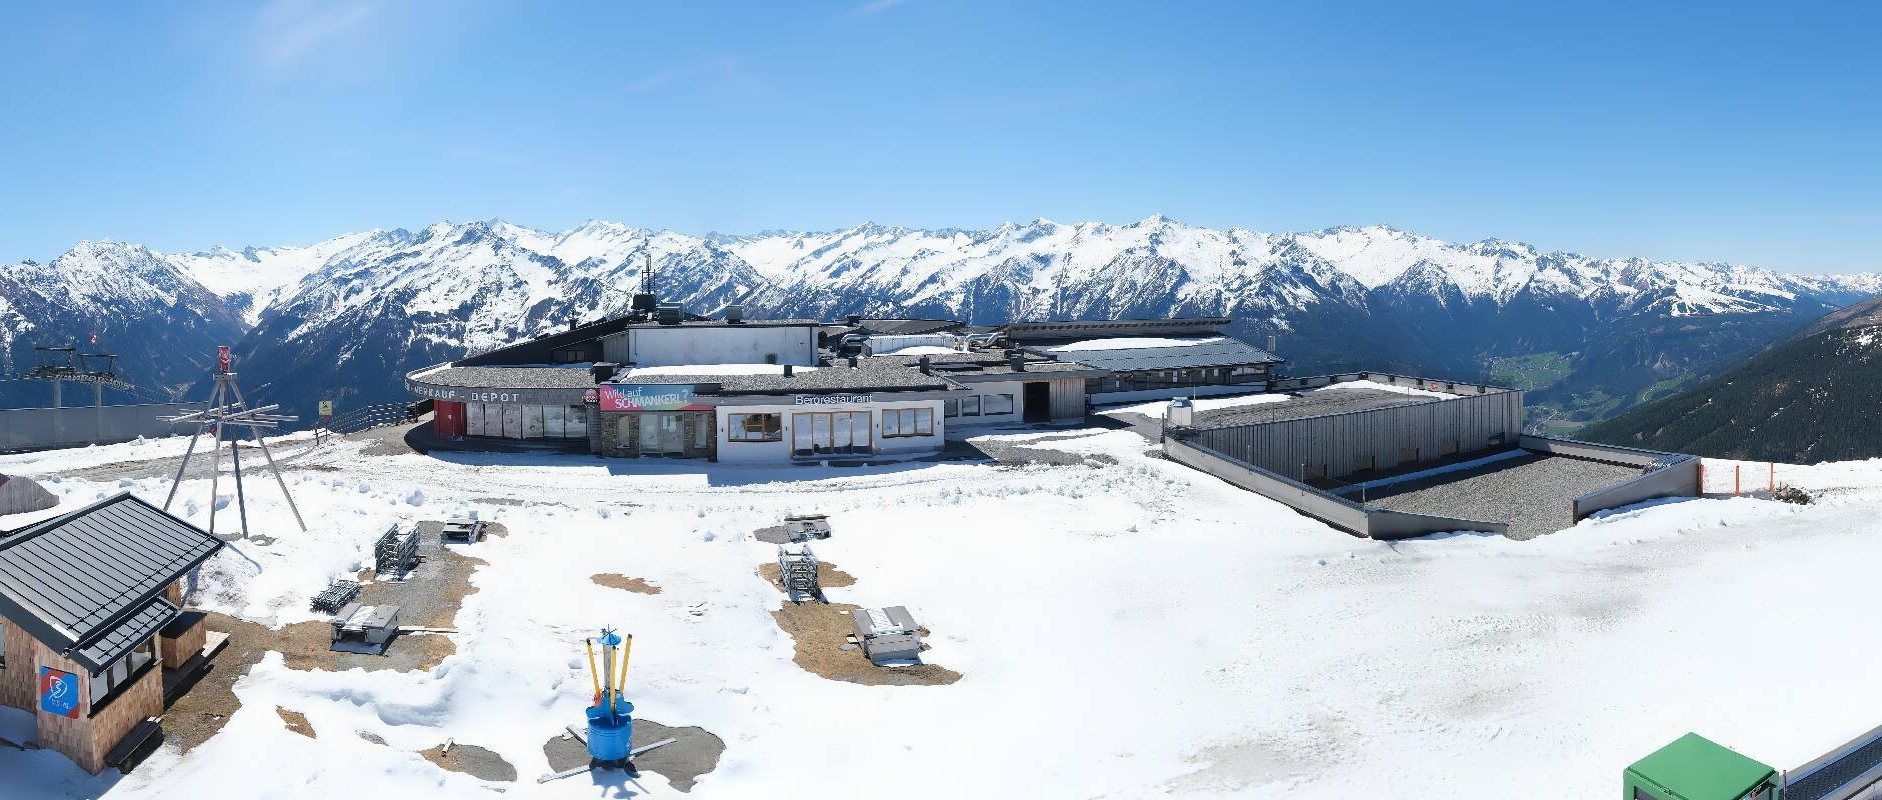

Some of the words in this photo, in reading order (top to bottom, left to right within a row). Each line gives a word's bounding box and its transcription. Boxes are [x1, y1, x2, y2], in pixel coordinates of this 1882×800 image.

[415, 387, 456, 399] VERKAUF
[471, 392, 520, 402] DEPOT
[605, 387, 625, 400] Wild
[627, 386, 643, 397] auf
[615, 388, 688, 409] SCHMANKERL?
[795, 393, 874, 405] Bergrestaurant
